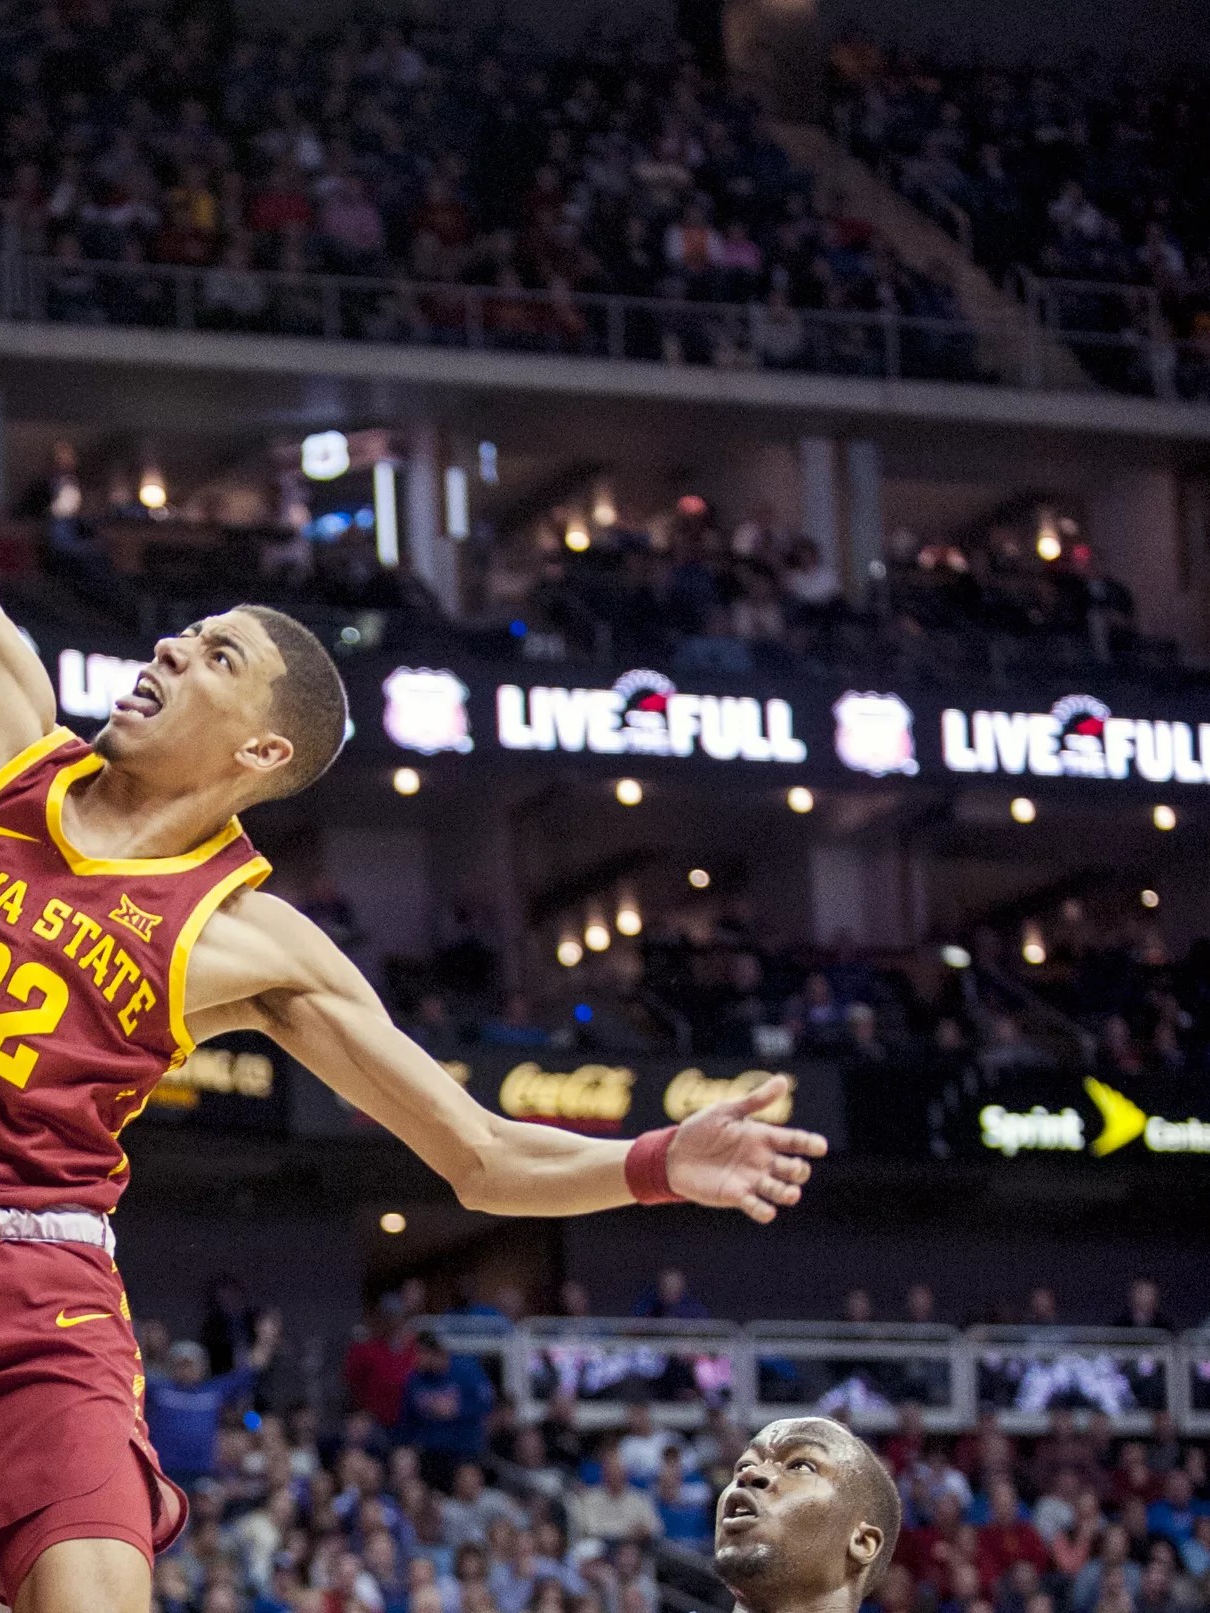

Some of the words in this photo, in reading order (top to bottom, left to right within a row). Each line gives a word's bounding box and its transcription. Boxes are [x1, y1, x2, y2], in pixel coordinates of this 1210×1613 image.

[59, 649, 148, 719] LIV
[497, 684, 627, 754] LIVE
[666, 693, 807, 763] FULL
[942, 708, 1062, 776] LIVE
[1103, 717, 1210, 784] FUL
[32, 898, 157, 1037] STATE
